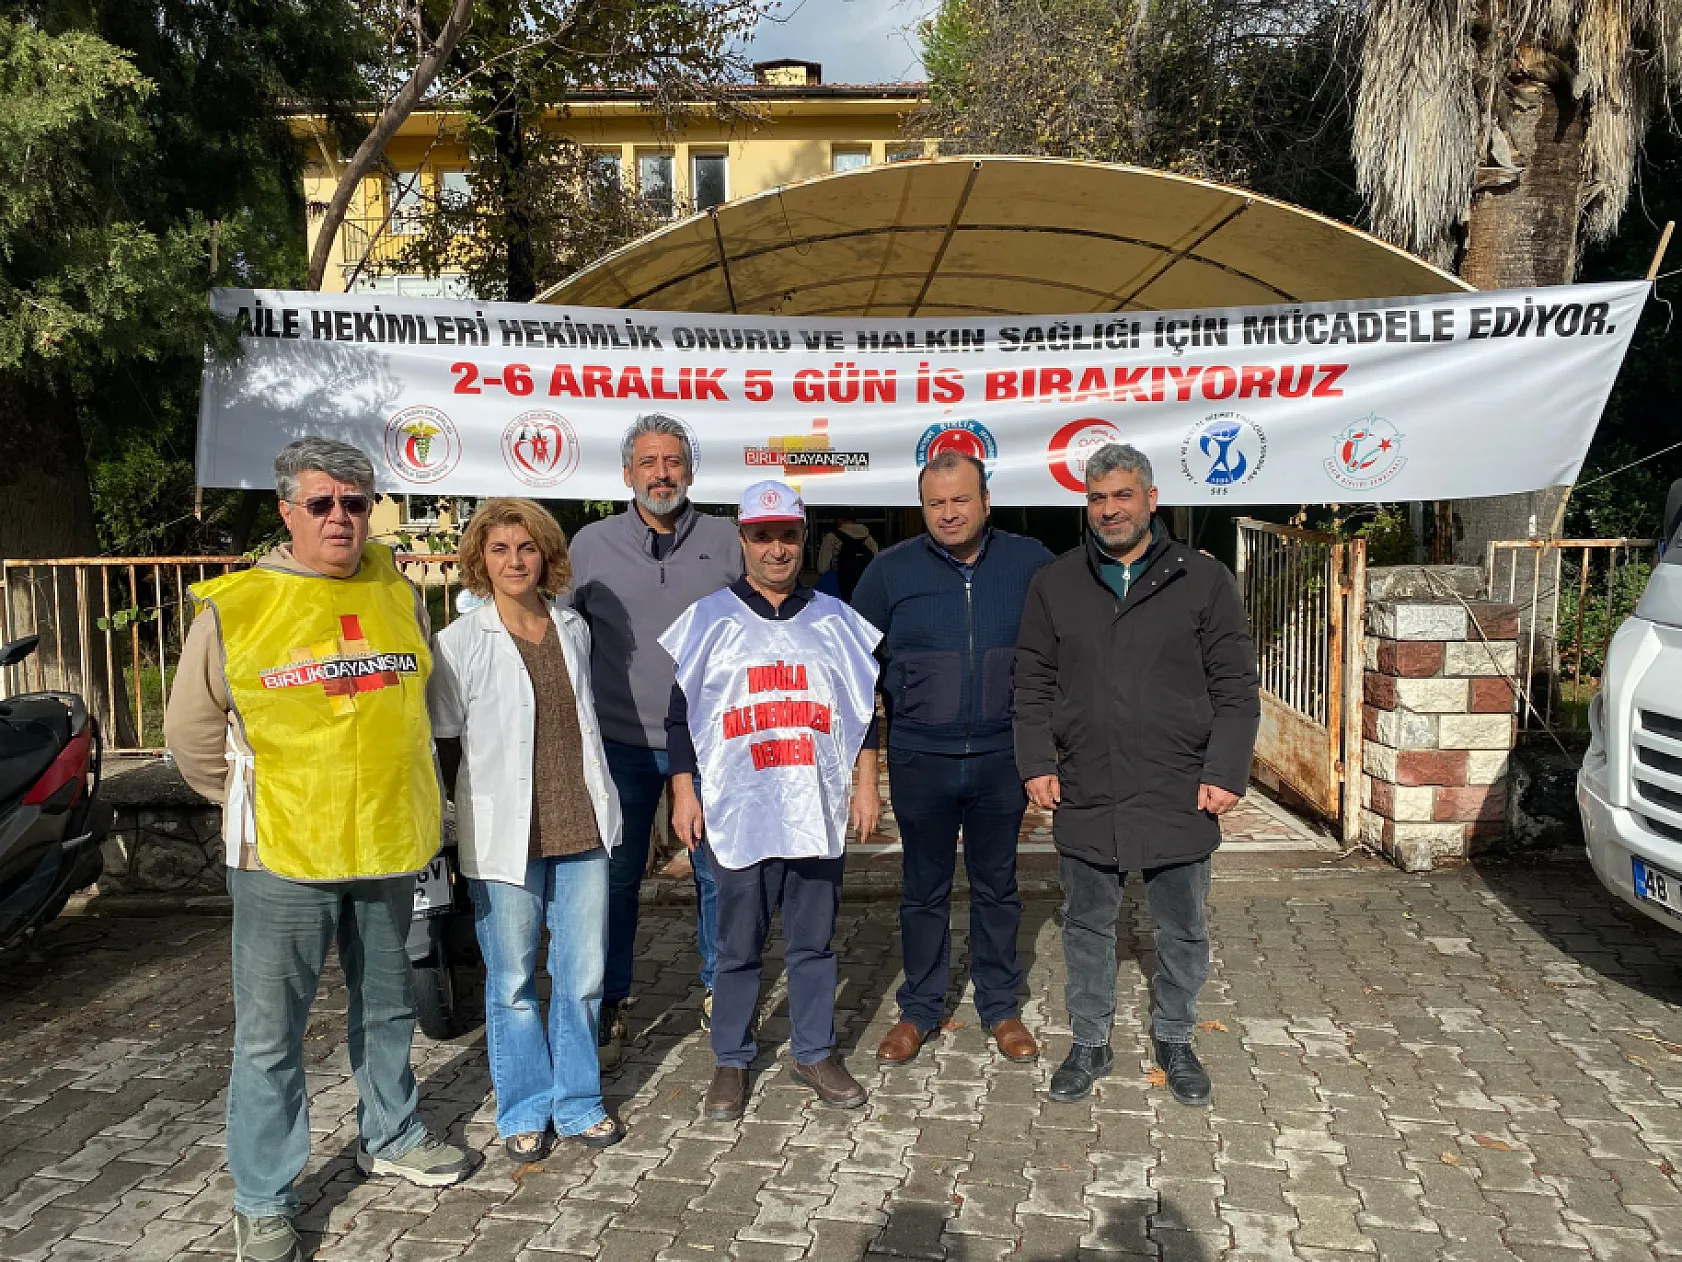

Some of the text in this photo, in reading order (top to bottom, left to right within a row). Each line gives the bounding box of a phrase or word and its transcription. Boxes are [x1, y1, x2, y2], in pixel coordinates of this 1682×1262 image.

[310, 305, 489, 346] HEKİMLERİ
[498, 314, 662, 350] HEKİMLİK
[671, 326, 791, 352] ONURU
[799, 330, 845, 353] VE
[856, 328, 985, 353] HALKIN
[999, 318, 1141, 352] SAĞLIĞI
[1154, 315, 1228, 356] İÇİN
[1243, 309, 1454, 346] MÜCADELE
[1468, 297, 1617, 340] EDİYOR.
[450, 361, 1349, 414] 2-6 ARALIK 5 GÜN İŞ BIRAKIYORUZ
